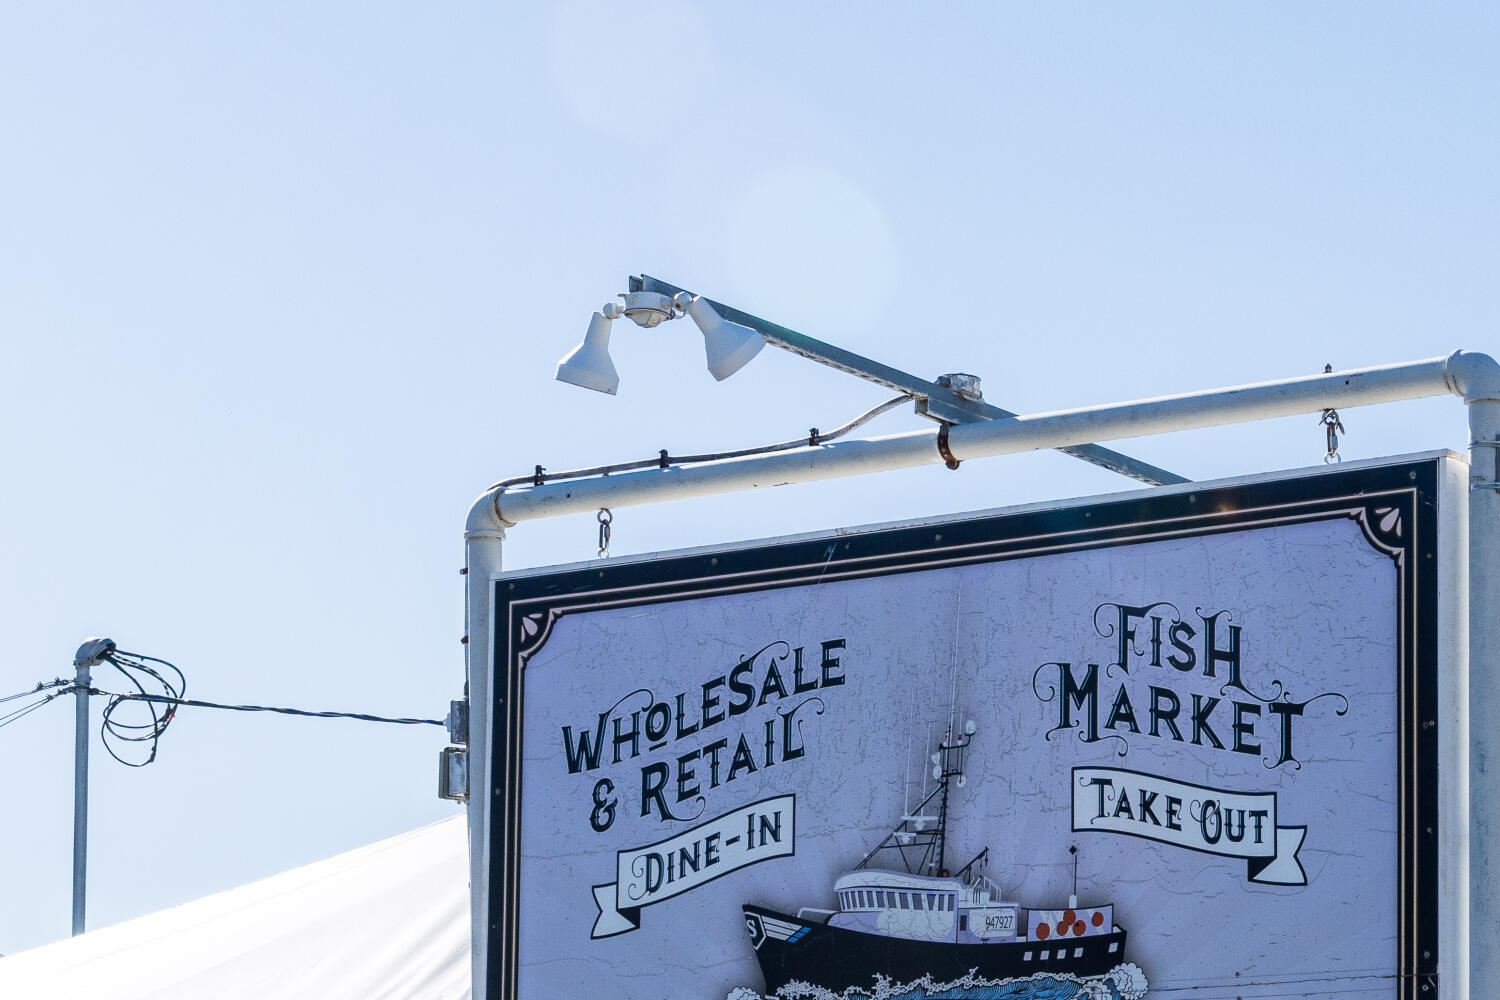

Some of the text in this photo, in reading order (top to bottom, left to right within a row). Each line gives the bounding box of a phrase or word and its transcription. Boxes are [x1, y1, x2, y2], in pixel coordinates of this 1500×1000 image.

[1093, 602, 1283, 703] FISH
[561, 638, 847, 775] WHOLESALE
[1033, 662, 1349, 770] MARKET
[588, 697, 825, 833] & RETAIL
[1079, 776, 1269, 845] TAKE OUT
[627, 809, 783, 901] DINE-IN
[985, 915, 1014, 930] 947927
